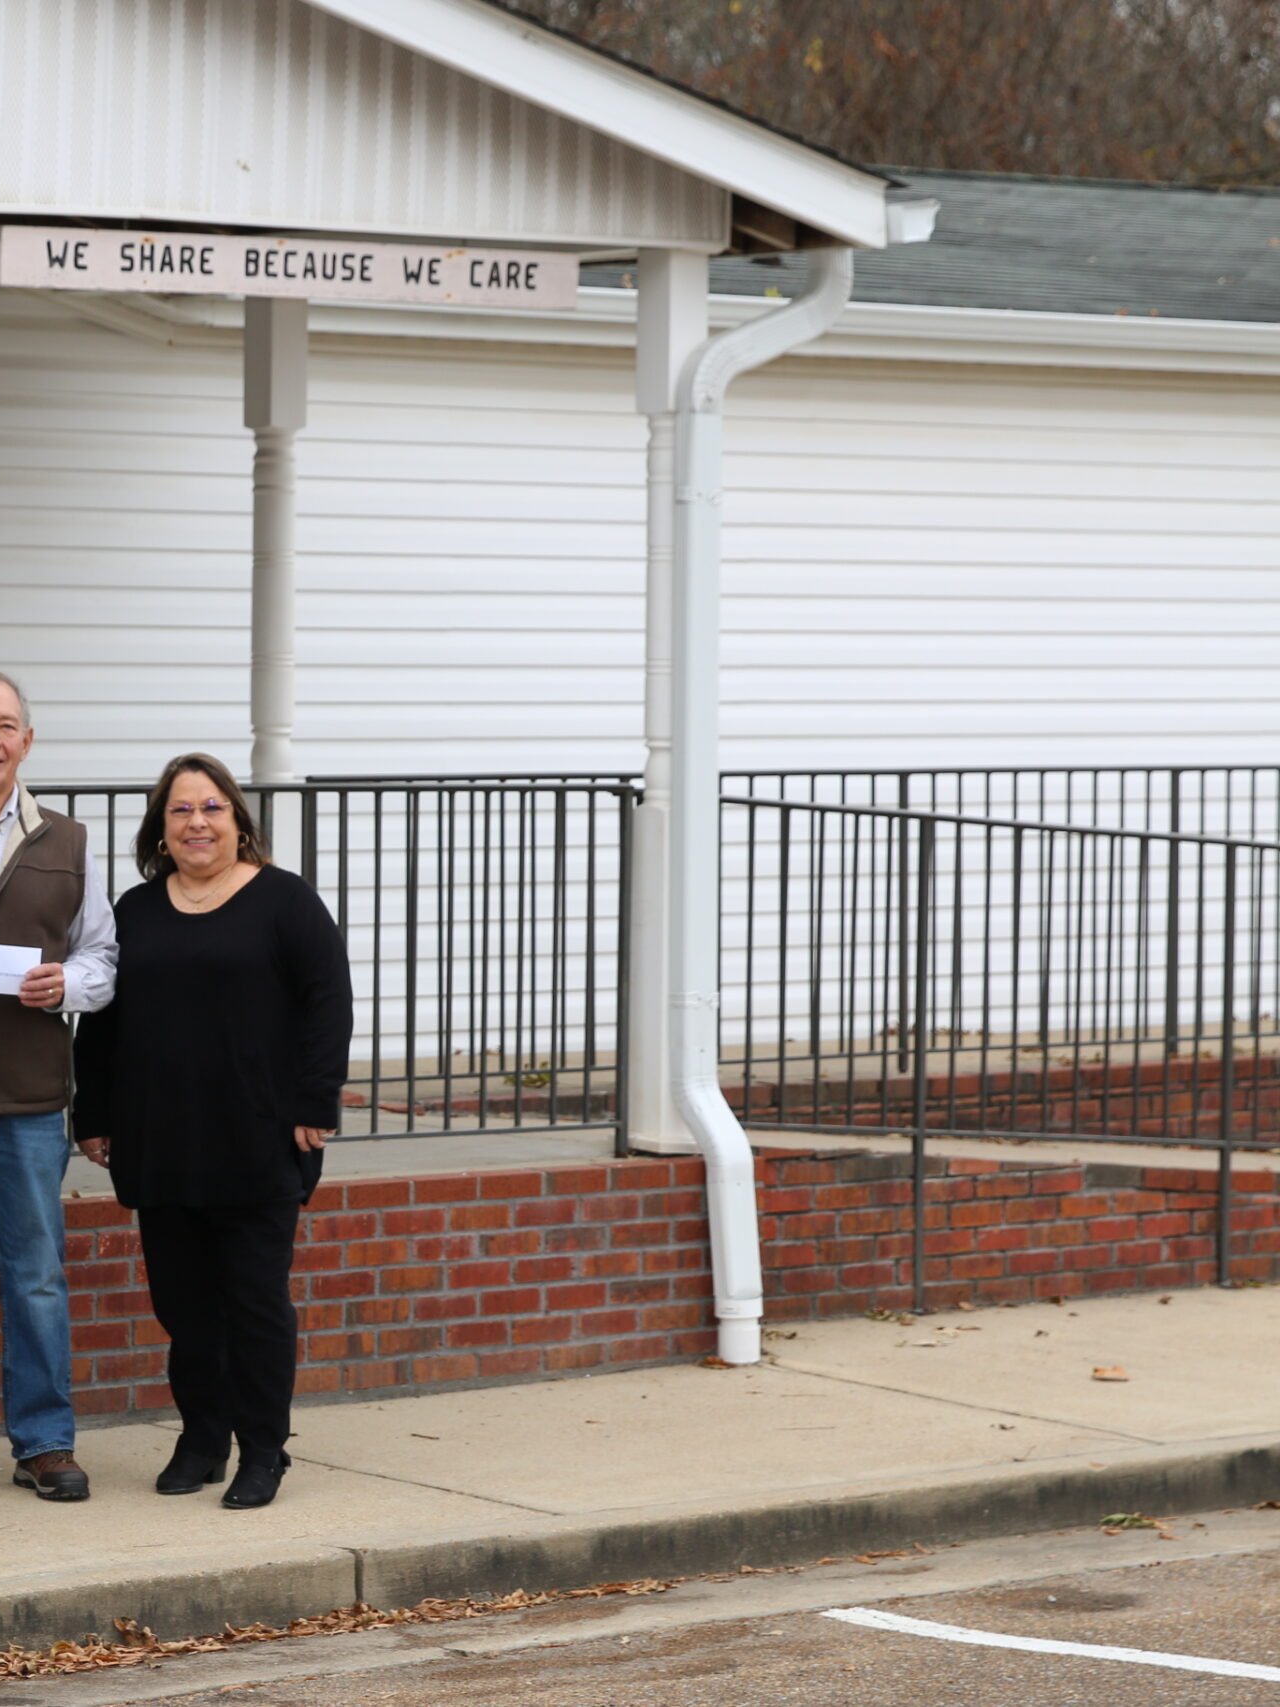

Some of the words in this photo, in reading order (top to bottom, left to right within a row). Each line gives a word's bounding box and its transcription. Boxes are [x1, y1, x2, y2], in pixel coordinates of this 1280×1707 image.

[46, 240, 89, 270] WE
[120, 243, 215, 275] SHARE
[244, 249, 374, 283] BECAUSE
[403, 256, 442, 285] WE
[470, 260, 539, 290] CARE
